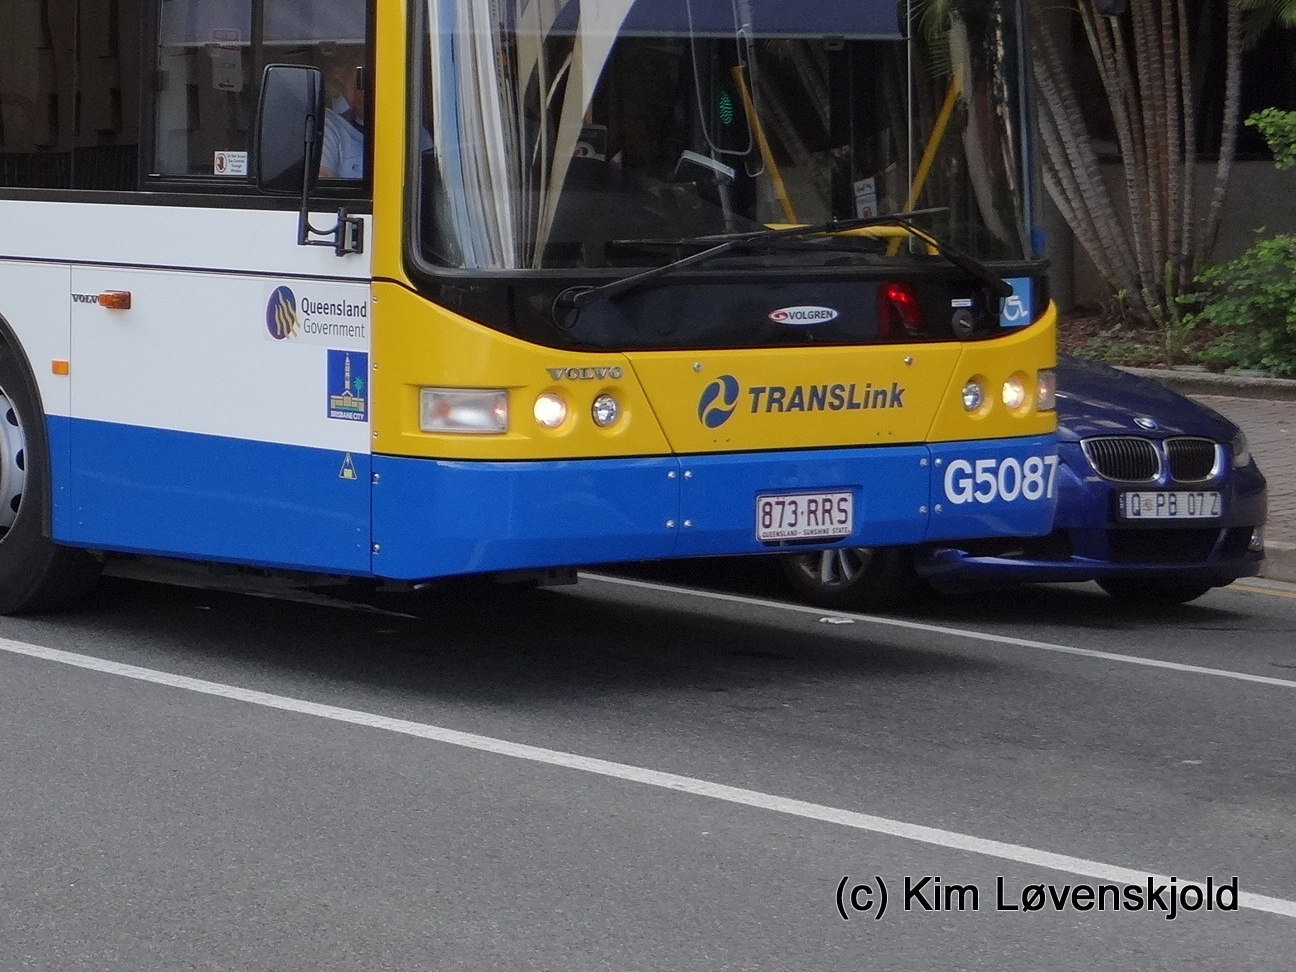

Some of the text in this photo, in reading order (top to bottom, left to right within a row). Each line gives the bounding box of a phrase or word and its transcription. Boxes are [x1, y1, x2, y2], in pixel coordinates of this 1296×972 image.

[70, 293, 100, 304] VOLV
[301, 297, 367, 318] Queensland
[788, 310, 834, 320] VOLGREN
[303, 318, 366, 339] Government
[546, 365, 625, 381] VOLVO
[747, 381, 906, 414] TRANSLink
[330, 410, 365, 420] BRISBANE CITY
[944, 454, 1058, 505] G5087
[762, 529, 798, 539] QUEENSLAND
[803, 527, 829, 536] SUNSHINE
[832, 526, 848, 534] STATE
